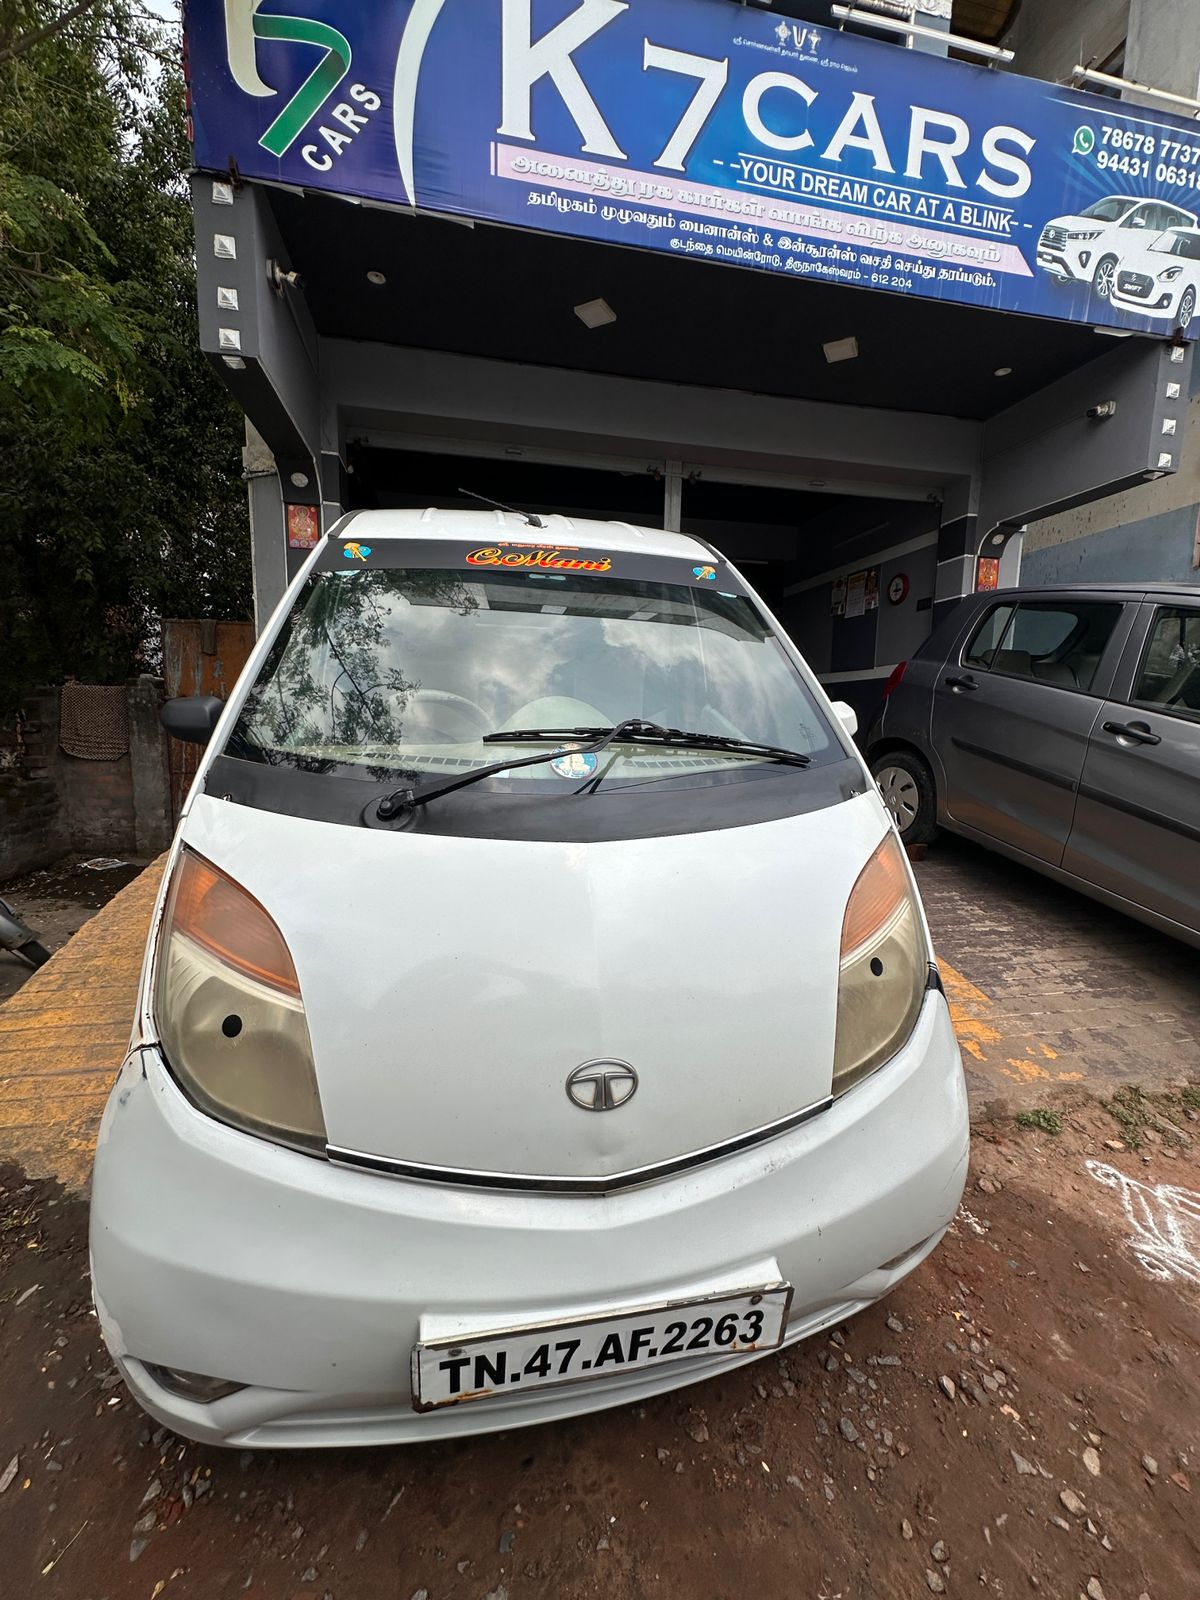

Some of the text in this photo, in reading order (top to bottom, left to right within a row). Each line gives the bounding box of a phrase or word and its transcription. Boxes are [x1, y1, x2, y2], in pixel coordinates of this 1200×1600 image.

[301, 83, 381, 172] CARS
[741, 71, 1038, 199] CARS
[1097, 151, 1149, 178] 94431
[1101, 126, 1155, 155] 78678
[740, 157, 1012, 233] YOUR DREAM CAR AT A BLINK
[527, 191, 598, 215] தமிழகம்
[601, 205, 676, 229] முழுவதும்
[679, 218, 760, 244] பைனான்ஸ்
[762, 233, 774, 247] &
[859, 252, 892, 270] வசதி
[894, 260, 936, 280] செய்து
[670, 237, 714, 256] குடந்தை
[871, 273, 889, 285] 612
[891, 276, 913, 289] 204
[439, 1309, 765, 1394] TN.47.AF.2263
